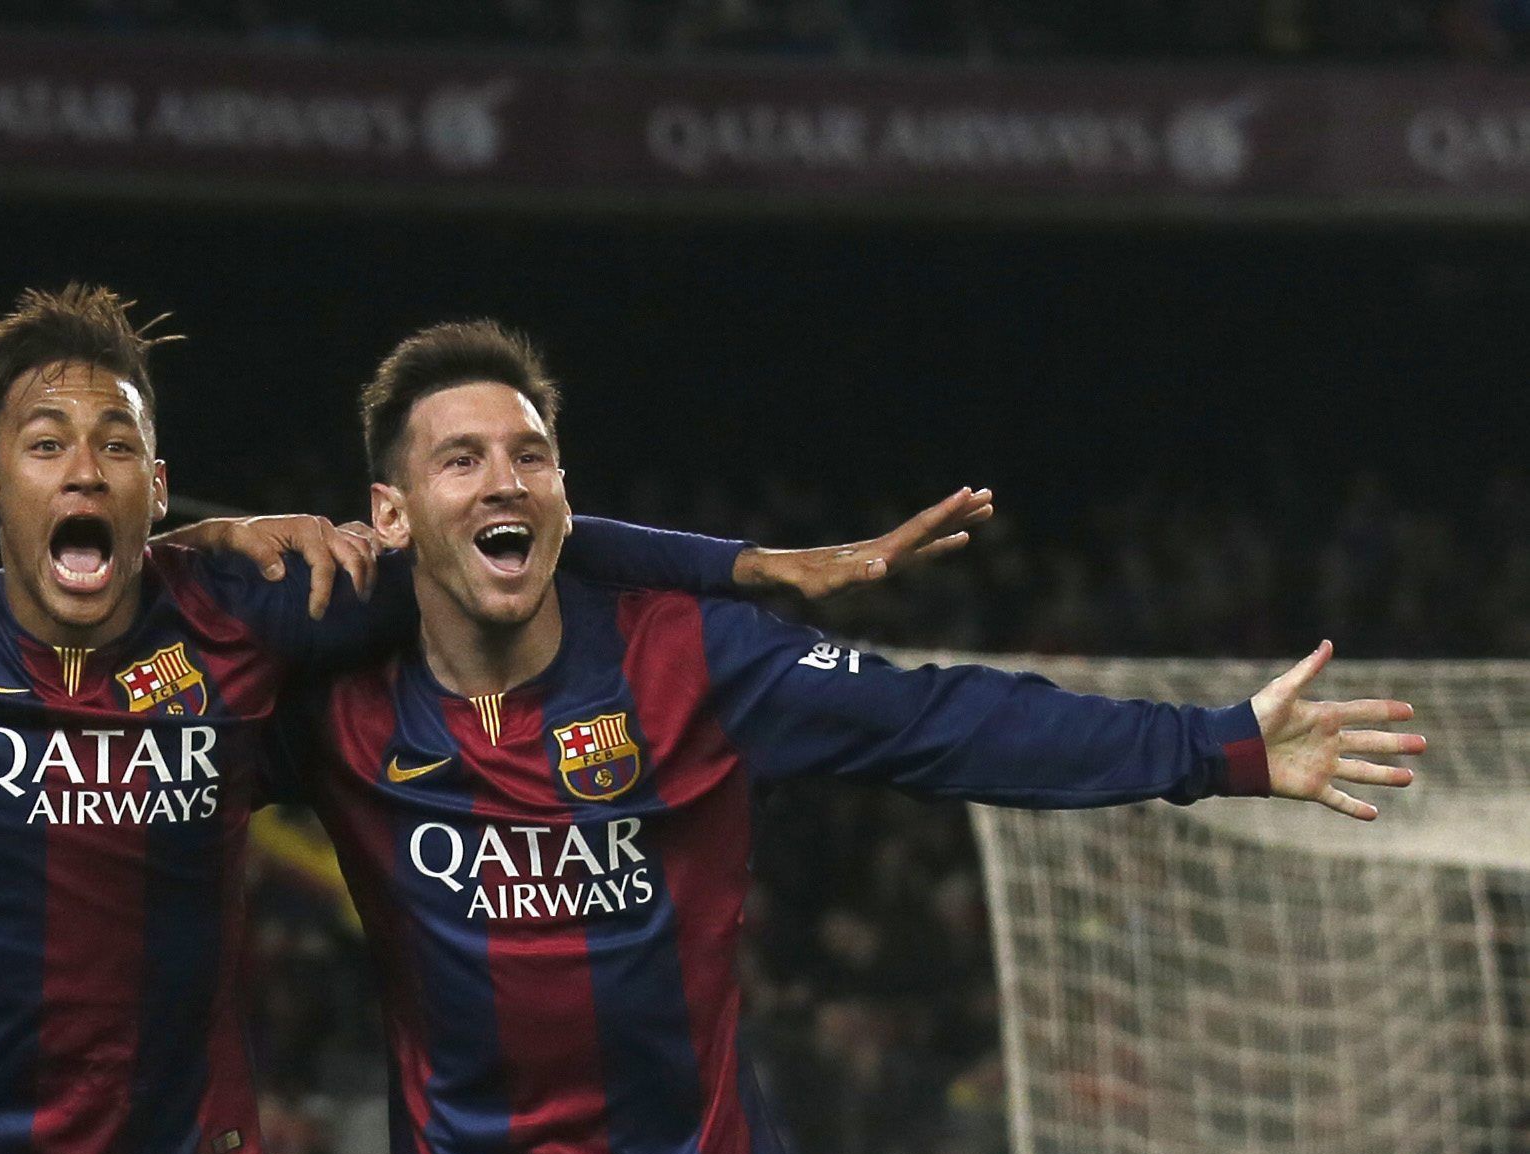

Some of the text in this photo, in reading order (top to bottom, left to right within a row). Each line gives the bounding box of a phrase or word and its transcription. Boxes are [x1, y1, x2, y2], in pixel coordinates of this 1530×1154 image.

[151, 681, 180, 703] FCB
[583, 749, 614, 766] FCB
[26, 784, 219, 825] AIRWAYS
[409, 816, 646, 892] QATAR
[466, 867, 653, 919] AIRWAYS
